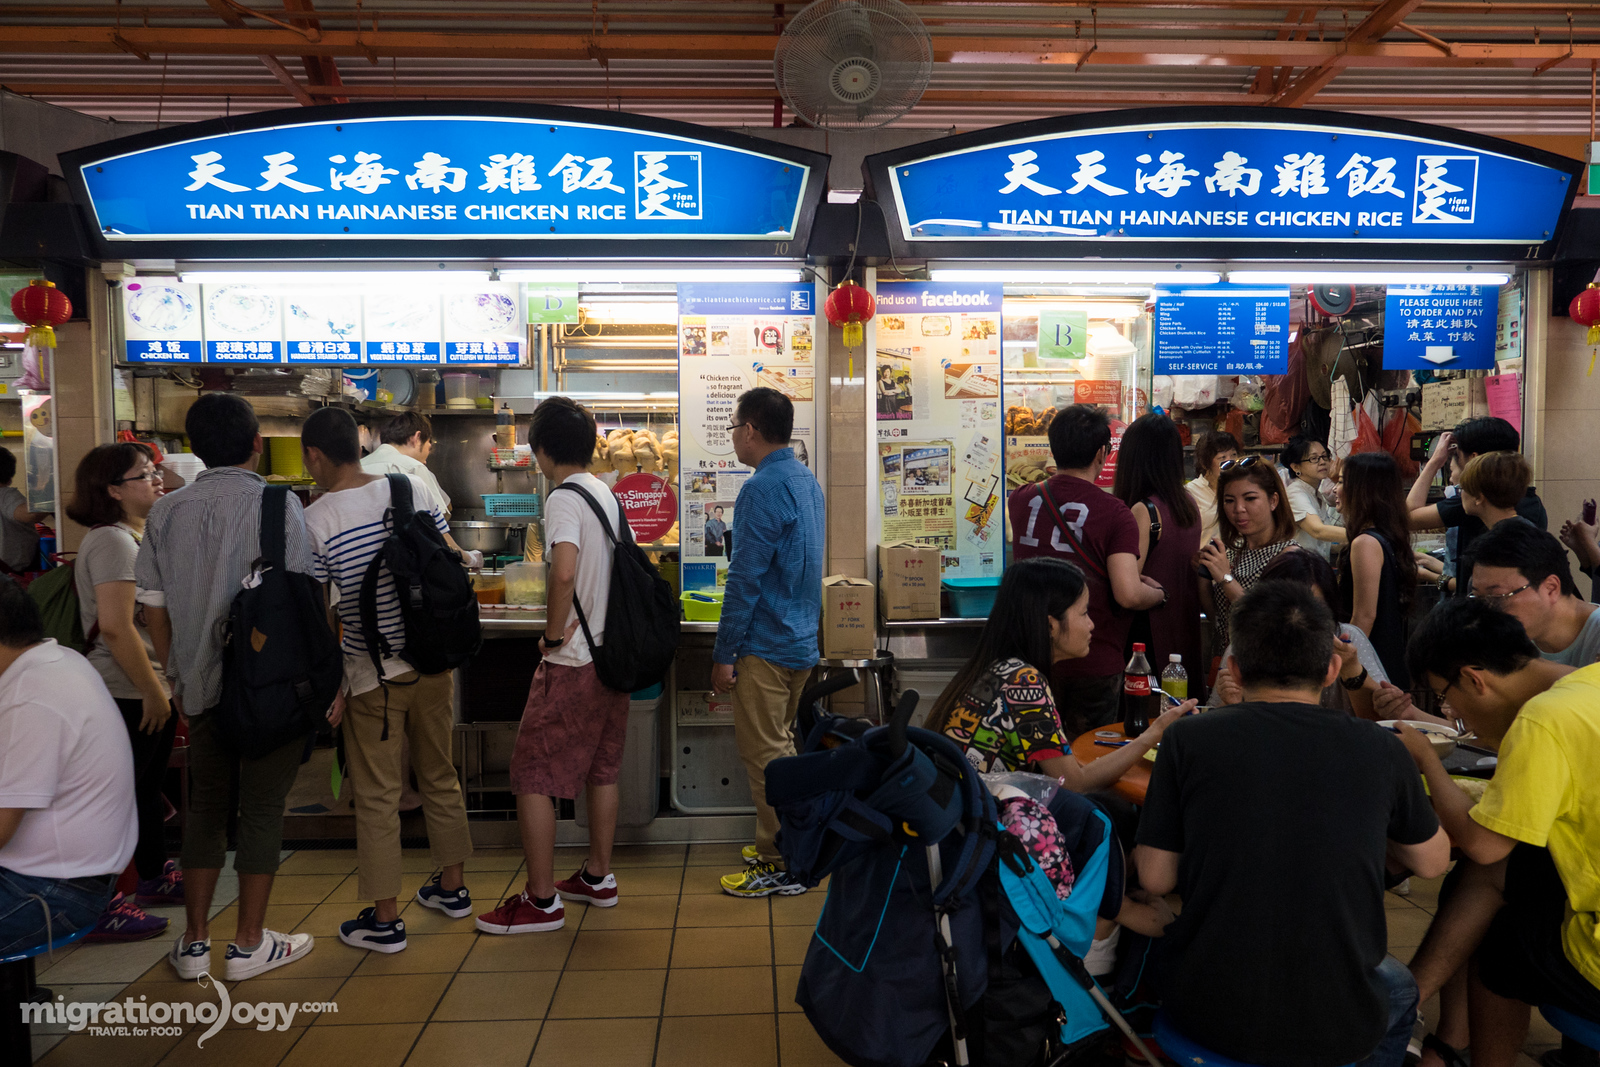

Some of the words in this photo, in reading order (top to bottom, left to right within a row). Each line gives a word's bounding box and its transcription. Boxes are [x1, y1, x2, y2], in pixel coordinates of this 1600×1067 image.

[184, 151, 625, 194] 天天海南雞飯
[998, 150, 1405, 198] 天天海南雞飯
[1448, 197, 1468, 206] tian
[186, 204, 244, 220] TIAN
[250, 204, 310, 220] TIAN
[318, 204, 456, 220] HAINANESE
[464, 204, 568, 220] CHICKEN
[577, 204, 626, 220] RICE
[999, 210, 1052, 224] TIAN
[1060, 210, 1112, 225] TIAN
[1120, 210, 1248, 226] HAINANESE
[1255, 211, 1350, 226] CHICKEN
[1358, 212, 1403, 226] RICE
[774, 242, 788, 256] 10
[1524, 246, 1540, 259] 11
[542, 287, 564, 310] D
[876, 294, 894, 306] Find
[896, 296, 904, 304] us
[906, 296, 916, 304] on
[1432, 299, 1460, 307] QUEUE
[1406, 319, 1478, 329] 请在此排队
[1055, 324, 1072, 346] B
[148, 341, 181, 352] 鸡饭
[628, 490, 667, 501] Singapore
